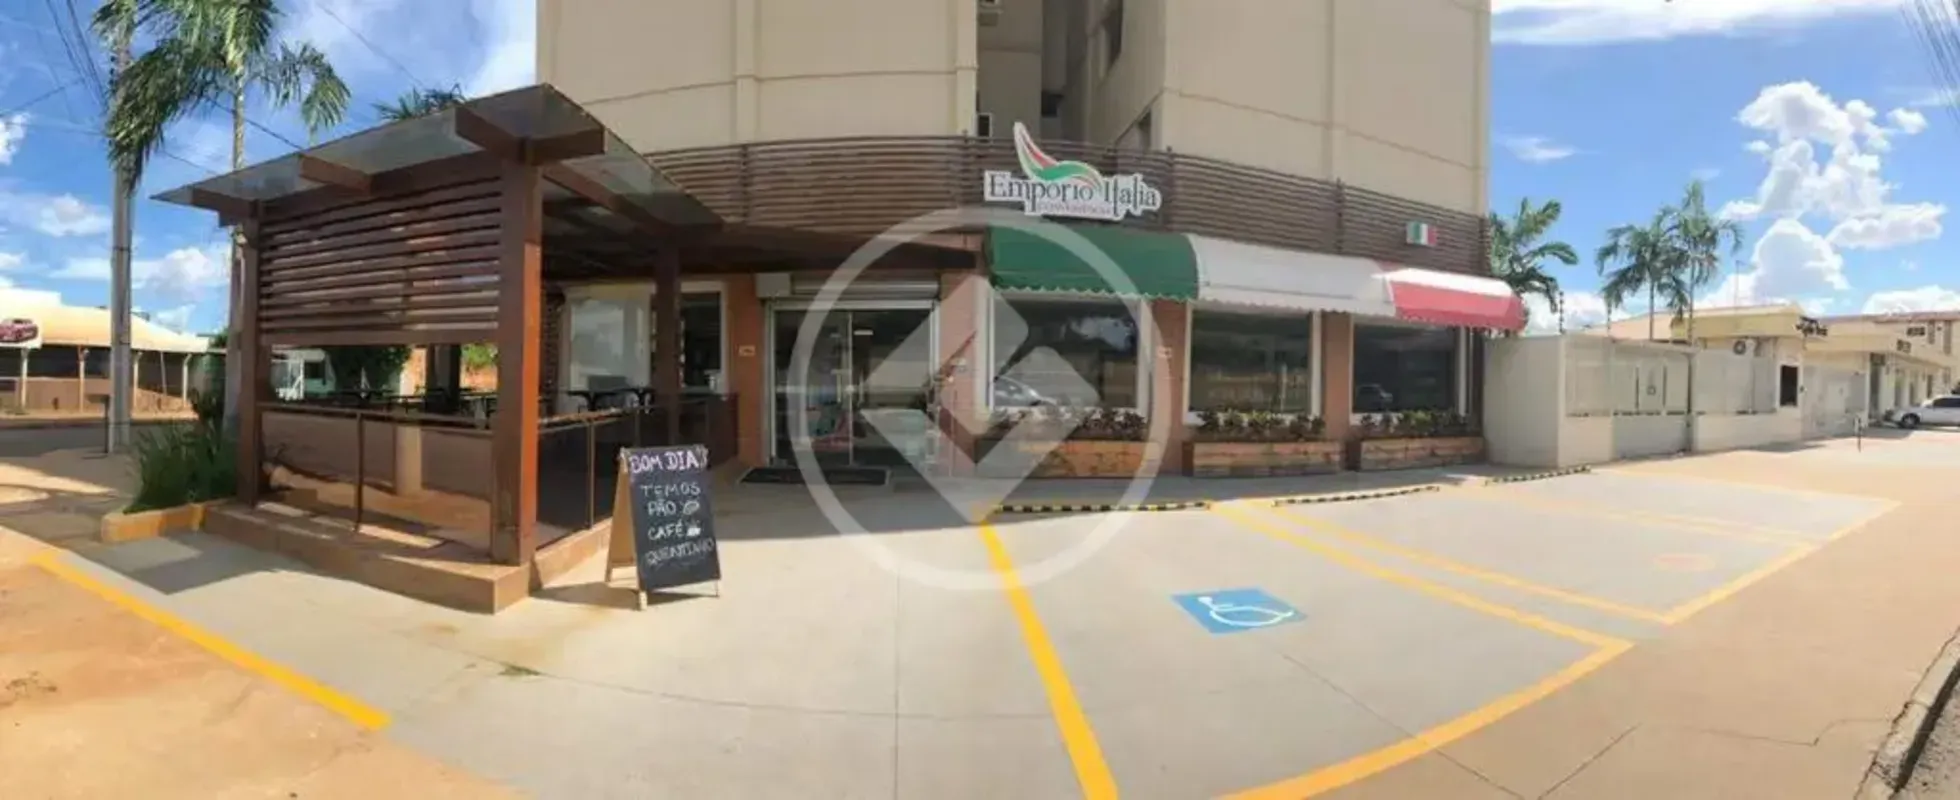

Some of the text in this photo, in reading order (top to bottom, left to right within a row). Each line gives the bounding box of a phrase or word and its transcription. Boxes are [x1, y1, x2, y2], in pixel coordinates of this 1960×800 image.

[1103, 176, 1156, 218] Italia
[631, 451, 700, 474] BOM DIA
[640, 482, 701, 497] TEMOS
[648, 499, 676, 516] PÃO
[648, 519, 684, 540] CAFÉ
